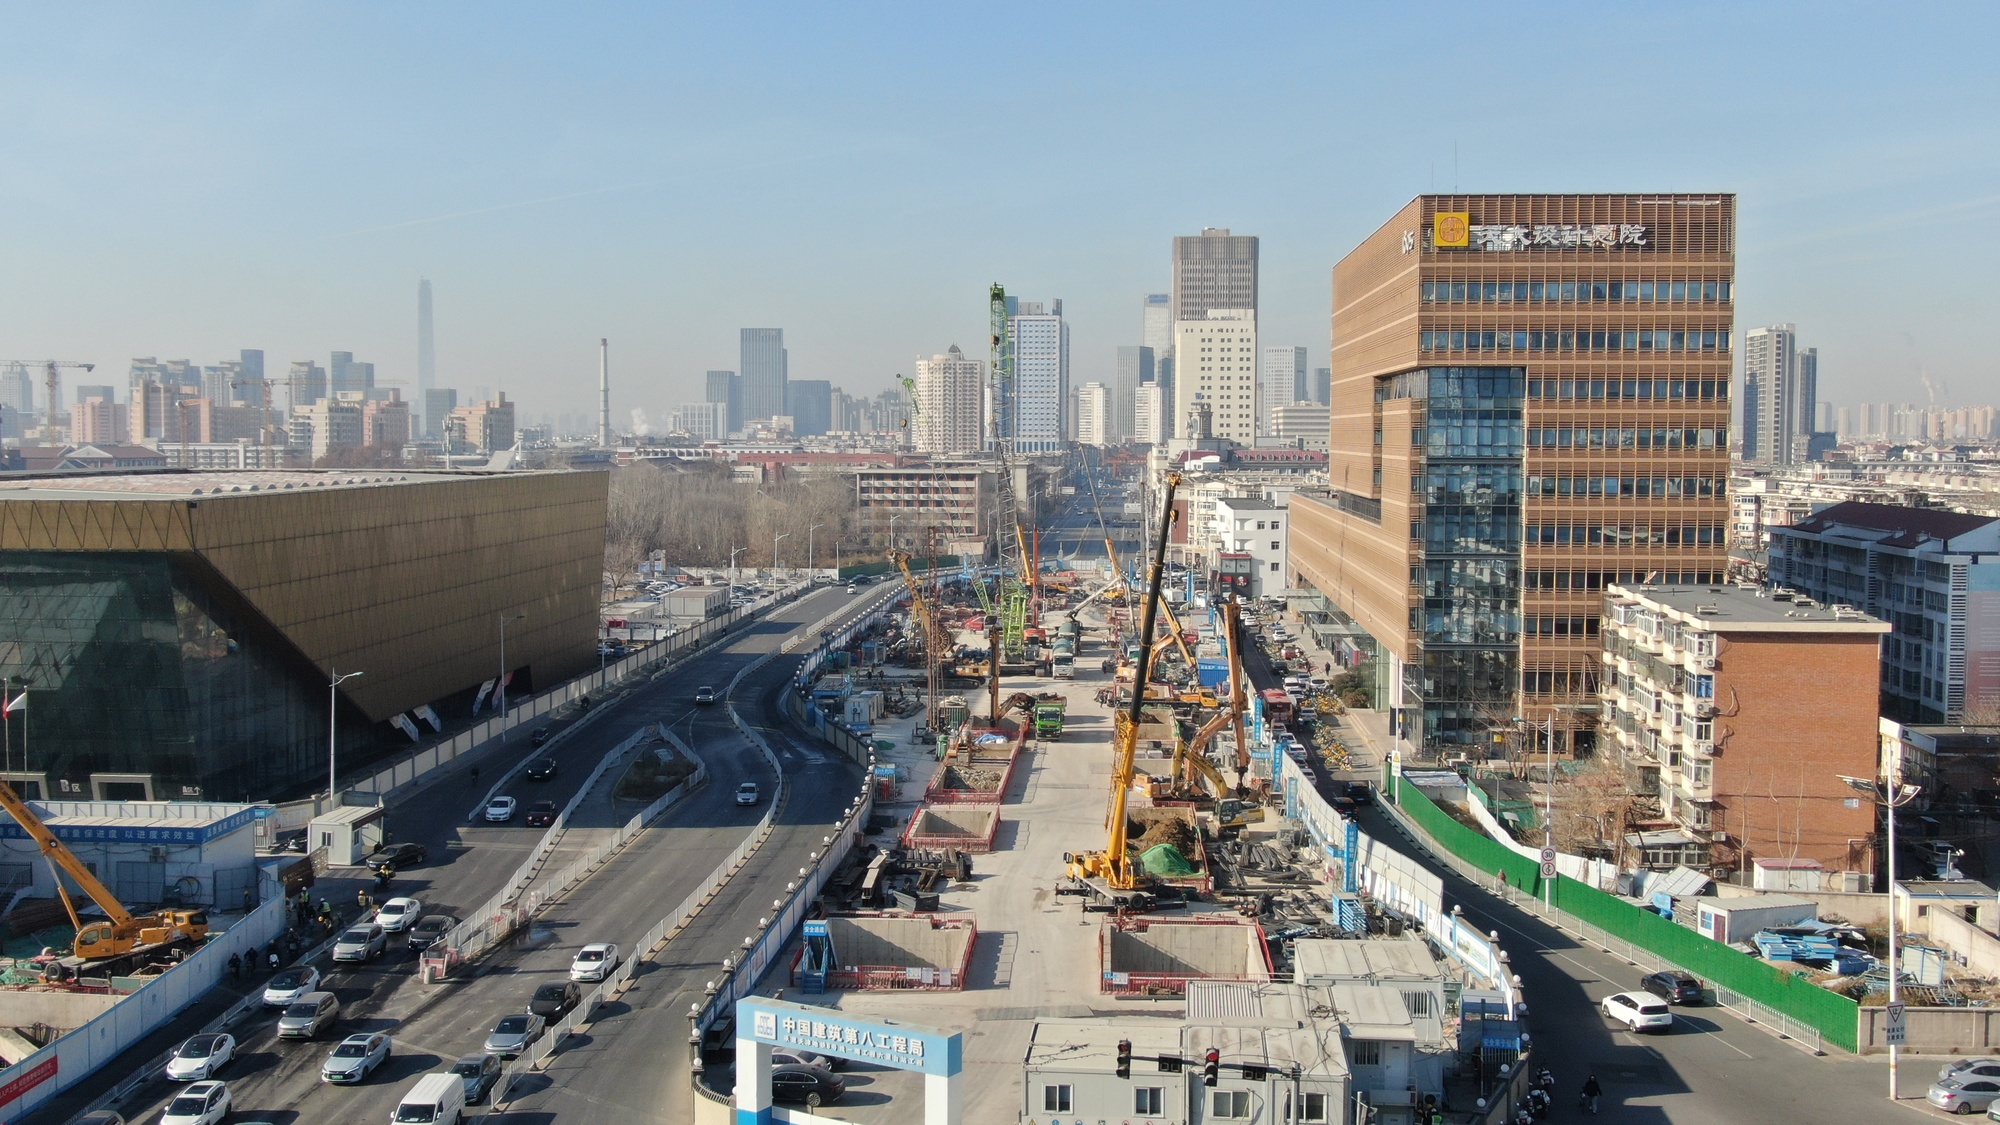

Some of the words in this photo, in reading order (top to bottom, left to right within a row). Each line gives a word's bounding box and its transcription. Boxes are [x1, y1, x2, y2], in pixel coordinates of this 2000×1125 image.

[125, 829, 195, 840] 以进度求效益
[782, 1016, 925, 1058] 中国建筑第八工程局
